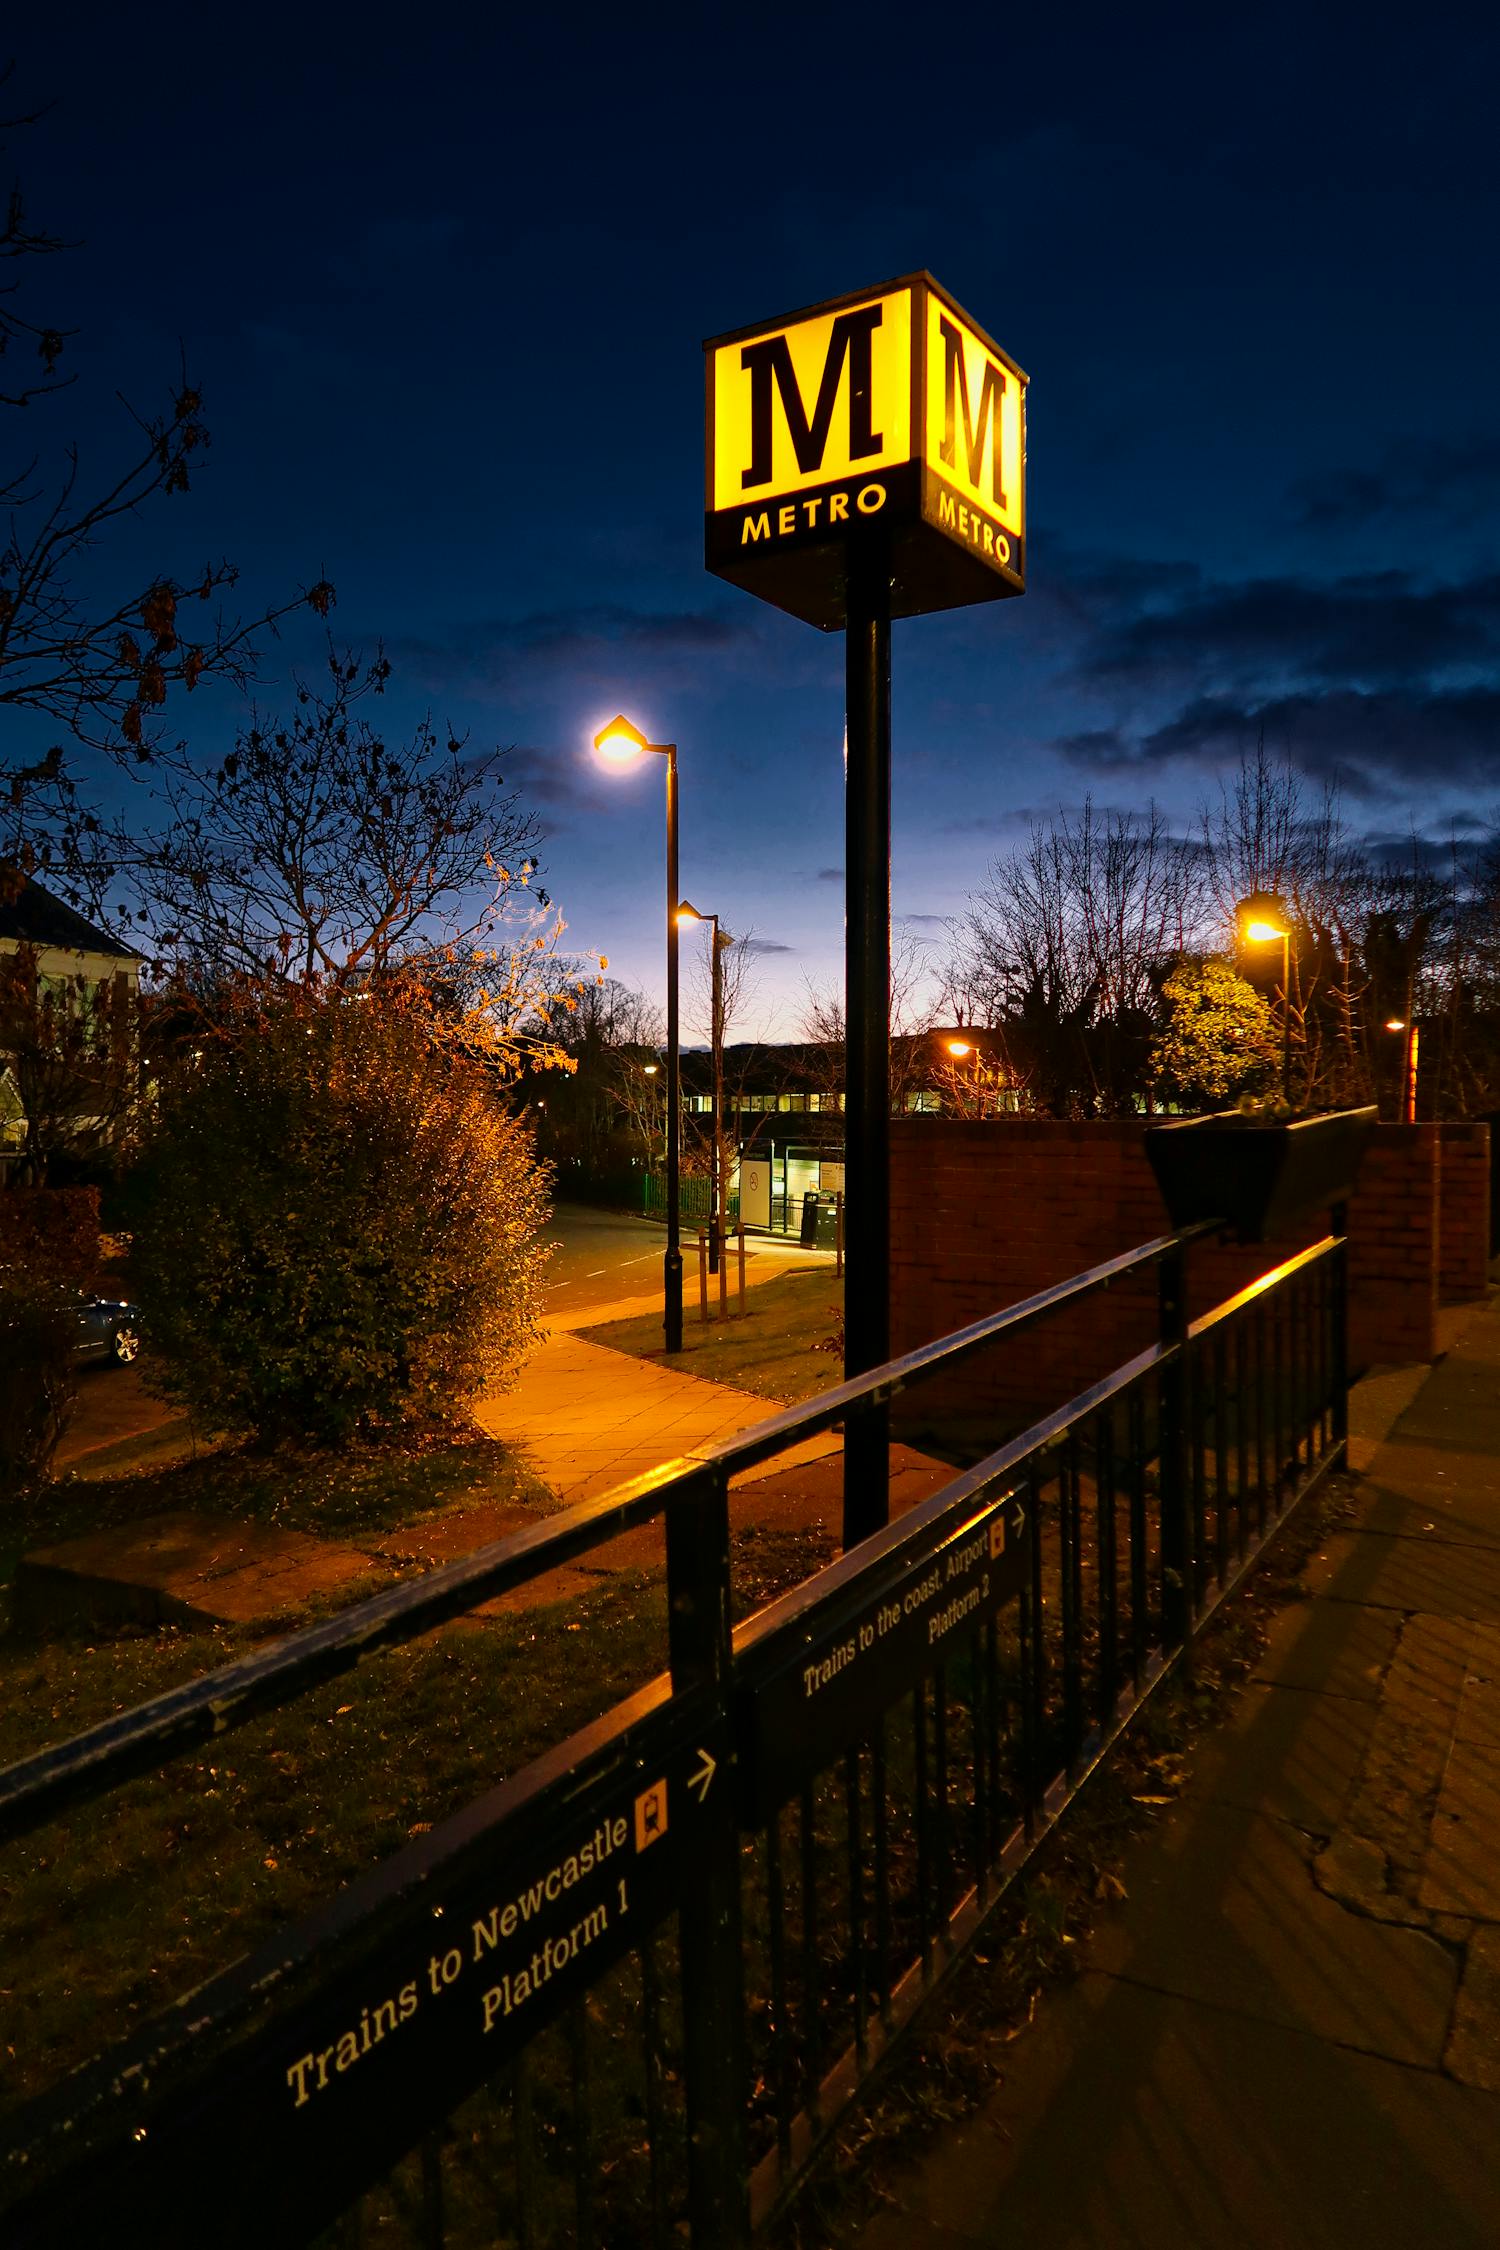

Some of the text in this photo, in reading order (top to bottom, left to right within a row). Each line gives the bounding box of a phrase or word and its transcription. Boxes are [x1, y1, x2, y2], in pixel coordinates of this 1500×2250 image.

[741, 302, 883, 490] M
[939, 311, 1007, 512] M
[741, 483, 887, 545] METRO
[938, 490, 1011, 565] METRO
[803, 1636, 856, 1698] Trains
[858, 1620, 875, 1652] to
[877, 1602, 901, 1637] the
[945, 1530, 989, 1583] Airport
[928, 1573, 990, 1645] Platform 2
[286, 1815, 628, 2107] Trains to Newcastle
[481, 1877, 630, 2034] Platform 1
